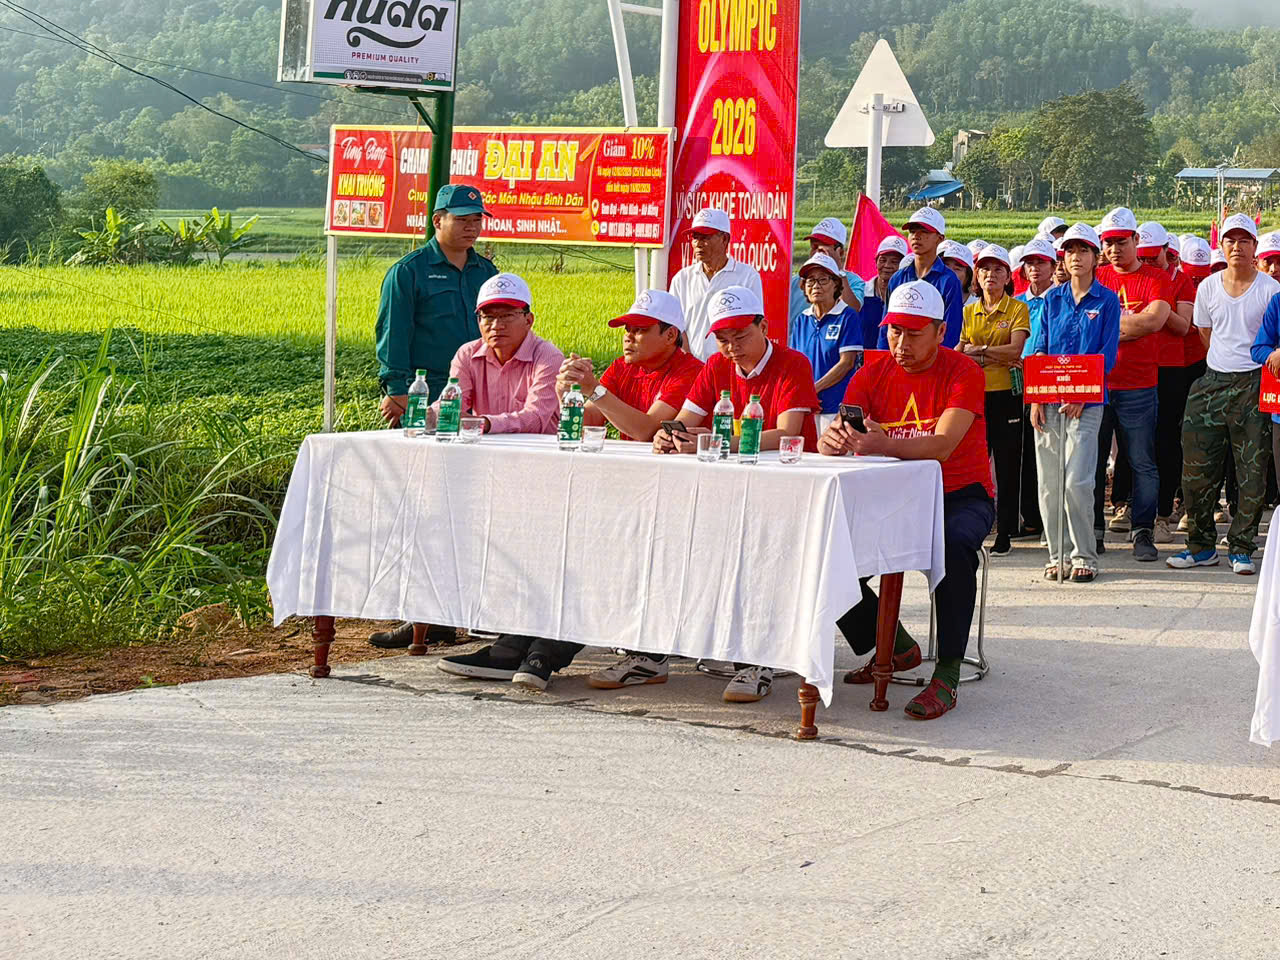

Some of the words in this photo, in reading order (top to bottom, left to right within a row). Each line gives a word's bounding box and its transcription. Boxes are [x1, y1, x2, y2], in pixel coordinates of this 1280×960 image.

[352, 51, 387, 62] PREMIUM
[388, 54, 420, 64] QUALITY
[710, 97, 757, 157] 2026
[603, 138, 627, 158] Giảm
[631, 136, 656, 160] 10%
[400, 147, 429, 179] CHẠM
[484, 139, 535, 189] ĐẠI
[536, 140, 580, 182] AN
[337, 173, 356, 196] KHAI
[738, 183, 765, 220] TOÀN
[766, 184, 788, 220] DÂN
[487, 218, 515, 234] HOAN,
[516, 219, 536, 233] SINH
[748, 232, 777, 272] QUỐC
